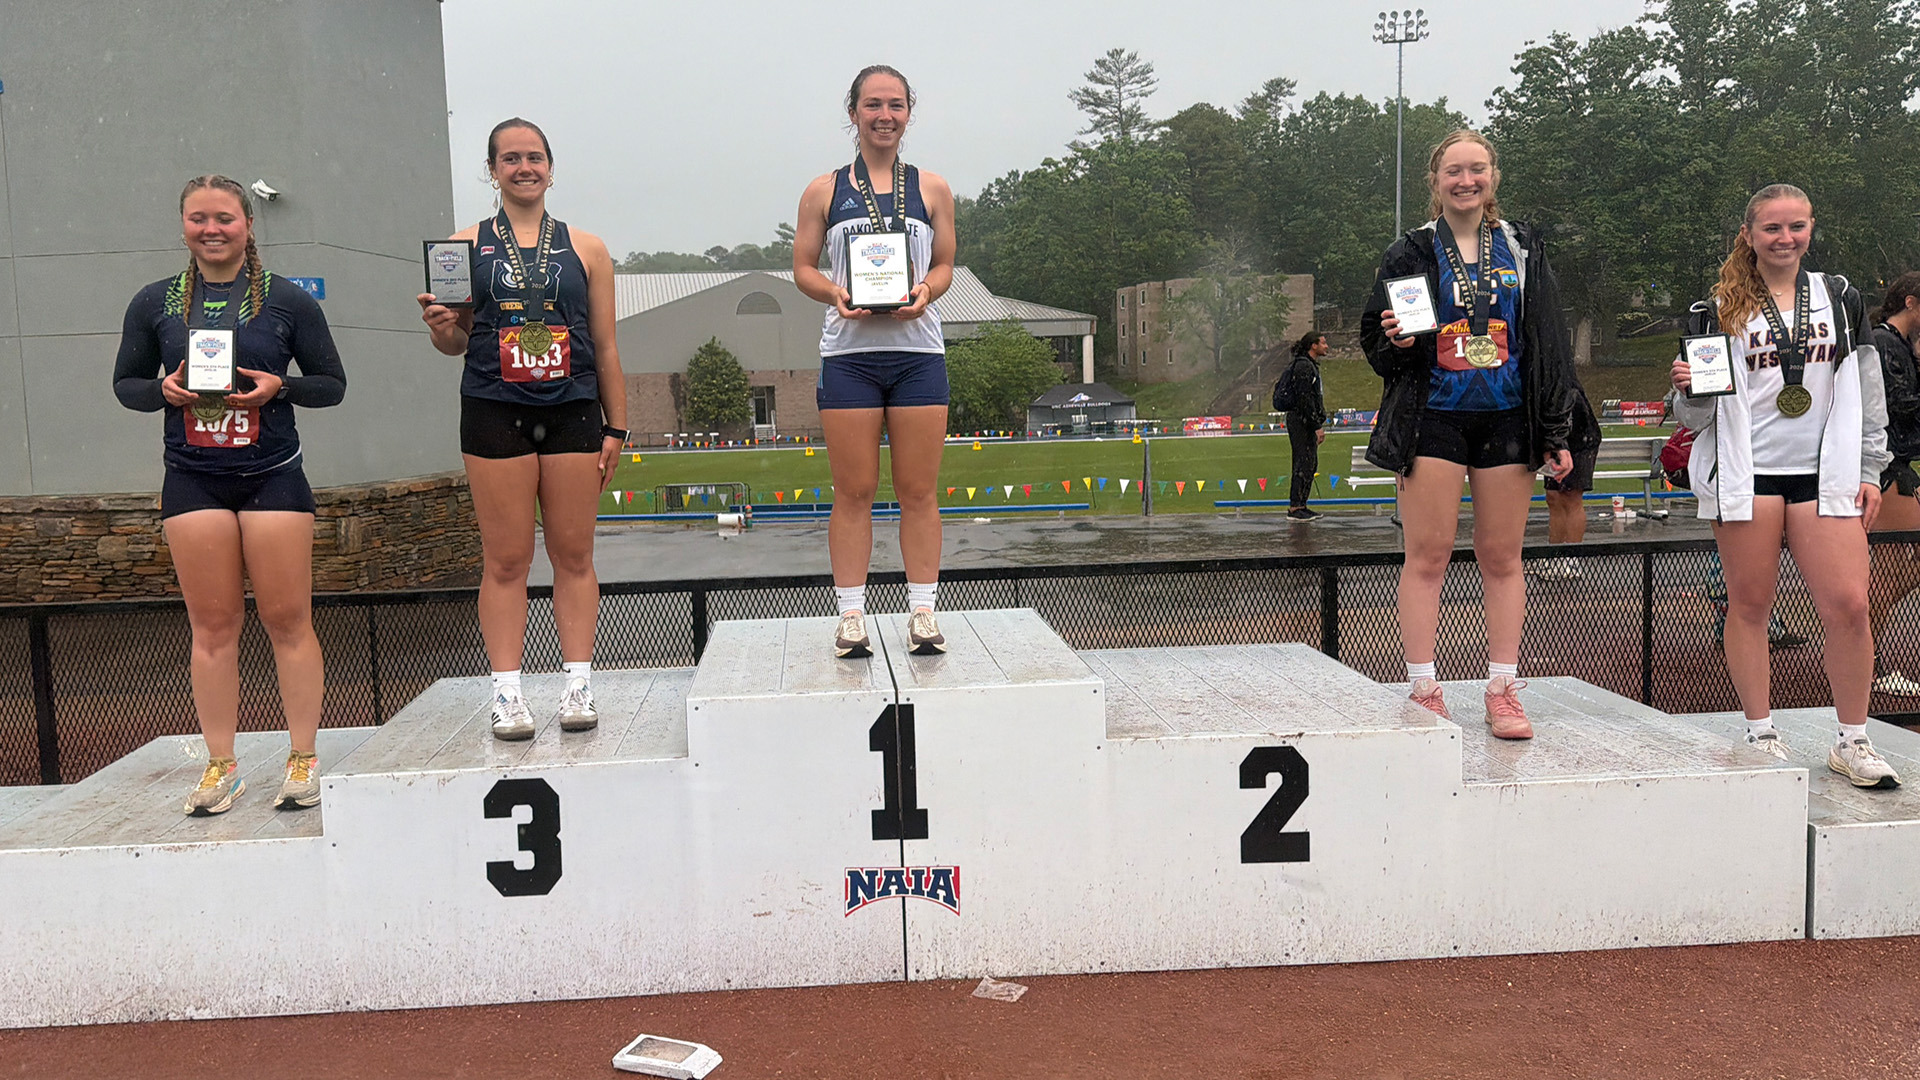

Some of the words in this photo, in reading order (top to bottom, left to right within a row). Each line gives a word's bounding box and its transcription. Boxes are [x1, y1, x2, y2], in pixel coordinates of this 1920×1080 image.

[499, 225, 526, 289] ALL-AMERICAN
[1445, 247, 1475, 317] ALL-AMERICAN
[1749, 322, 1829, 349] KAAS
[1798, 285, 1809, 354] ALL-AMERICAN
[510, 343, 562, 368] 1033
[870, 704, 930, 840] 1
[1240, 746, 1311, 863] 2
[484, 778, 563, 896] 3
[846, 867, 958, 911] NAIA
